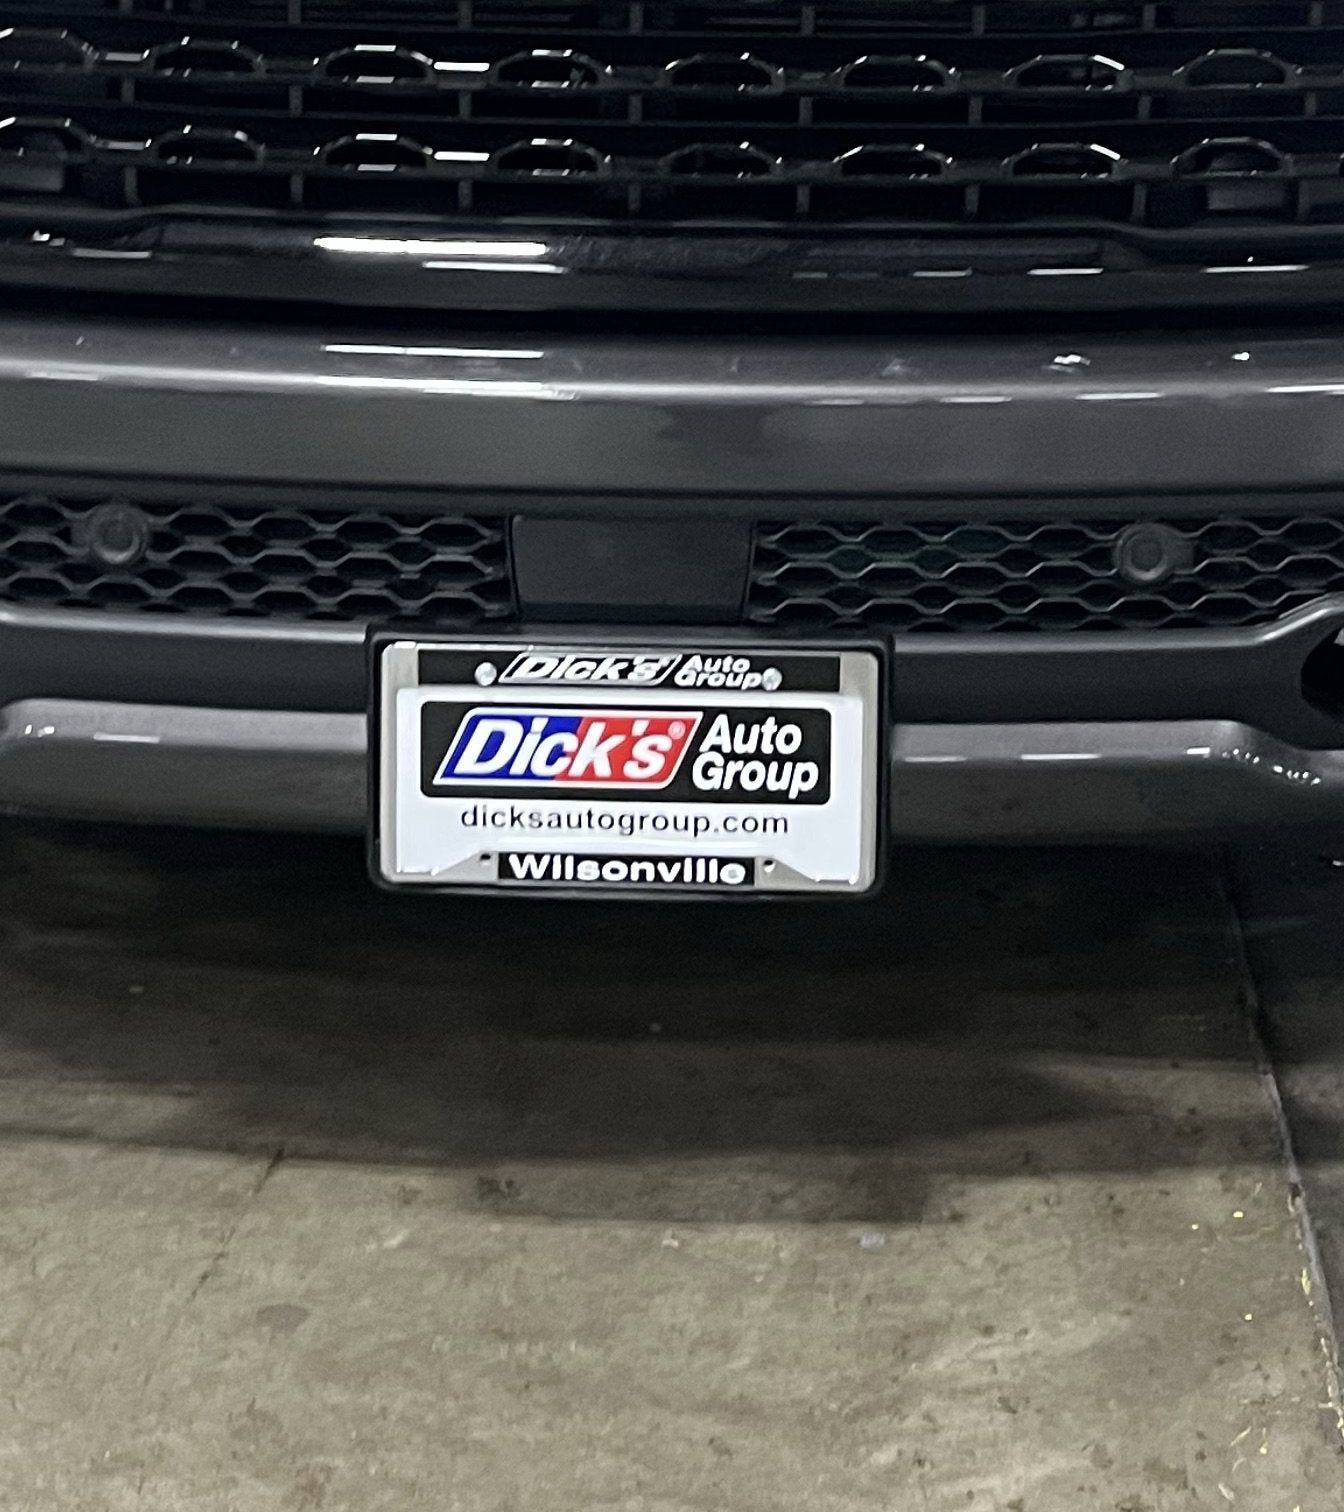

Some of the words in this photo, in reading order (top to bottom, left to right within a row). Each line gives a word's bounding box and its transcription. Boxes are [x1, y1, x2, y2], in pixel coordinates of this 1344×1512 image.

[674, 669, 764, 690] Group
[683, 654, 752, 674] Auto
[698, 713, 802, 755] Auto
[692, 752, 819, 798] Group
[461, 805, 789, 836] dicksautogroup.com
[508, 853, 746, 885] Wilsonville
